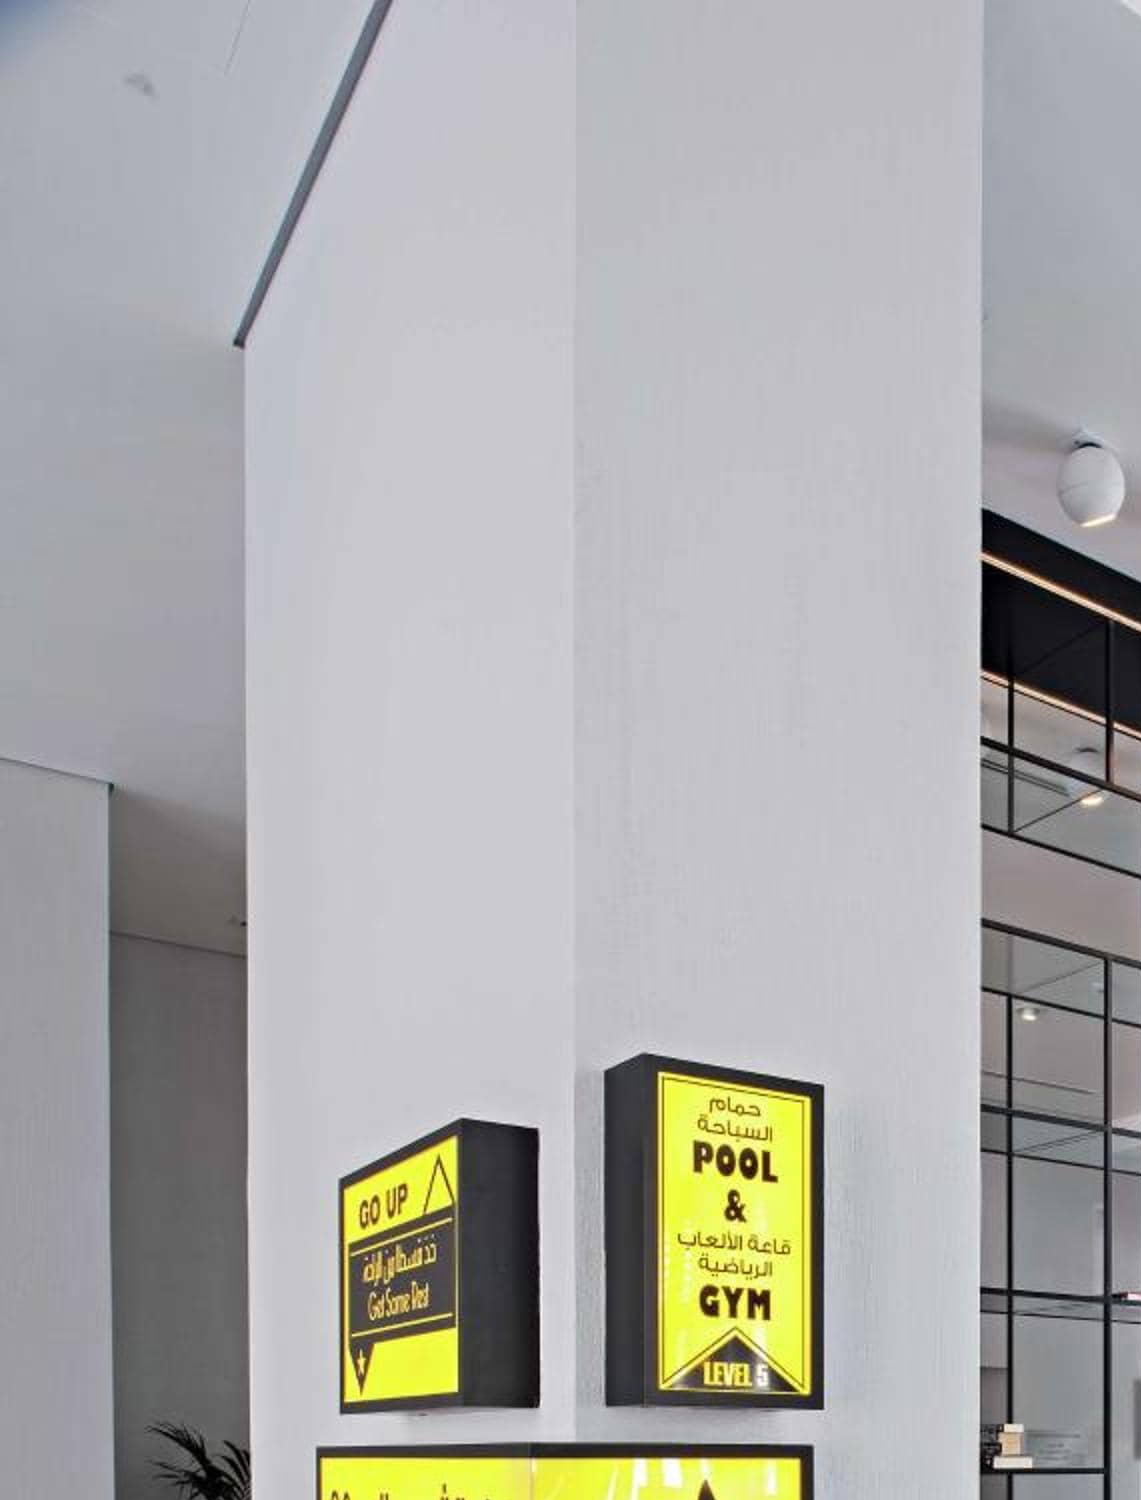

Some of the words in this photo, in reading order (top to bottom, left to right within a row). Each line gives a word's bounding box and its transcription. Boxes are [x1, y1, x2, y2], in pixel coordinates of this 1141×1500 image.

[708, 1096, 761, 1117] حمام
[697, 1114, 773, 1143] السباحة
[693, 1140, 778, 1183] POOL
[359, 1194, 380, 1229] GO
[386, 1183, 408, 1219] UP
[724, 1189, 747, 1223] &
[677, 1231, 743, 1250] الألعاب
[747, 1233, 791, 1255] قاعة
[698, 1253, 773, 1280] الرياضية
[368, 1291, 385, 1321] Get
[385, 1287, 410, 1318] Some
[411, 1280, 429, 1311] Rest
[699, 1284, 771, 1321] GYM
[703, 1361, 753, 1388] LEVEL
[755, 1363, 769, 1391] 5
